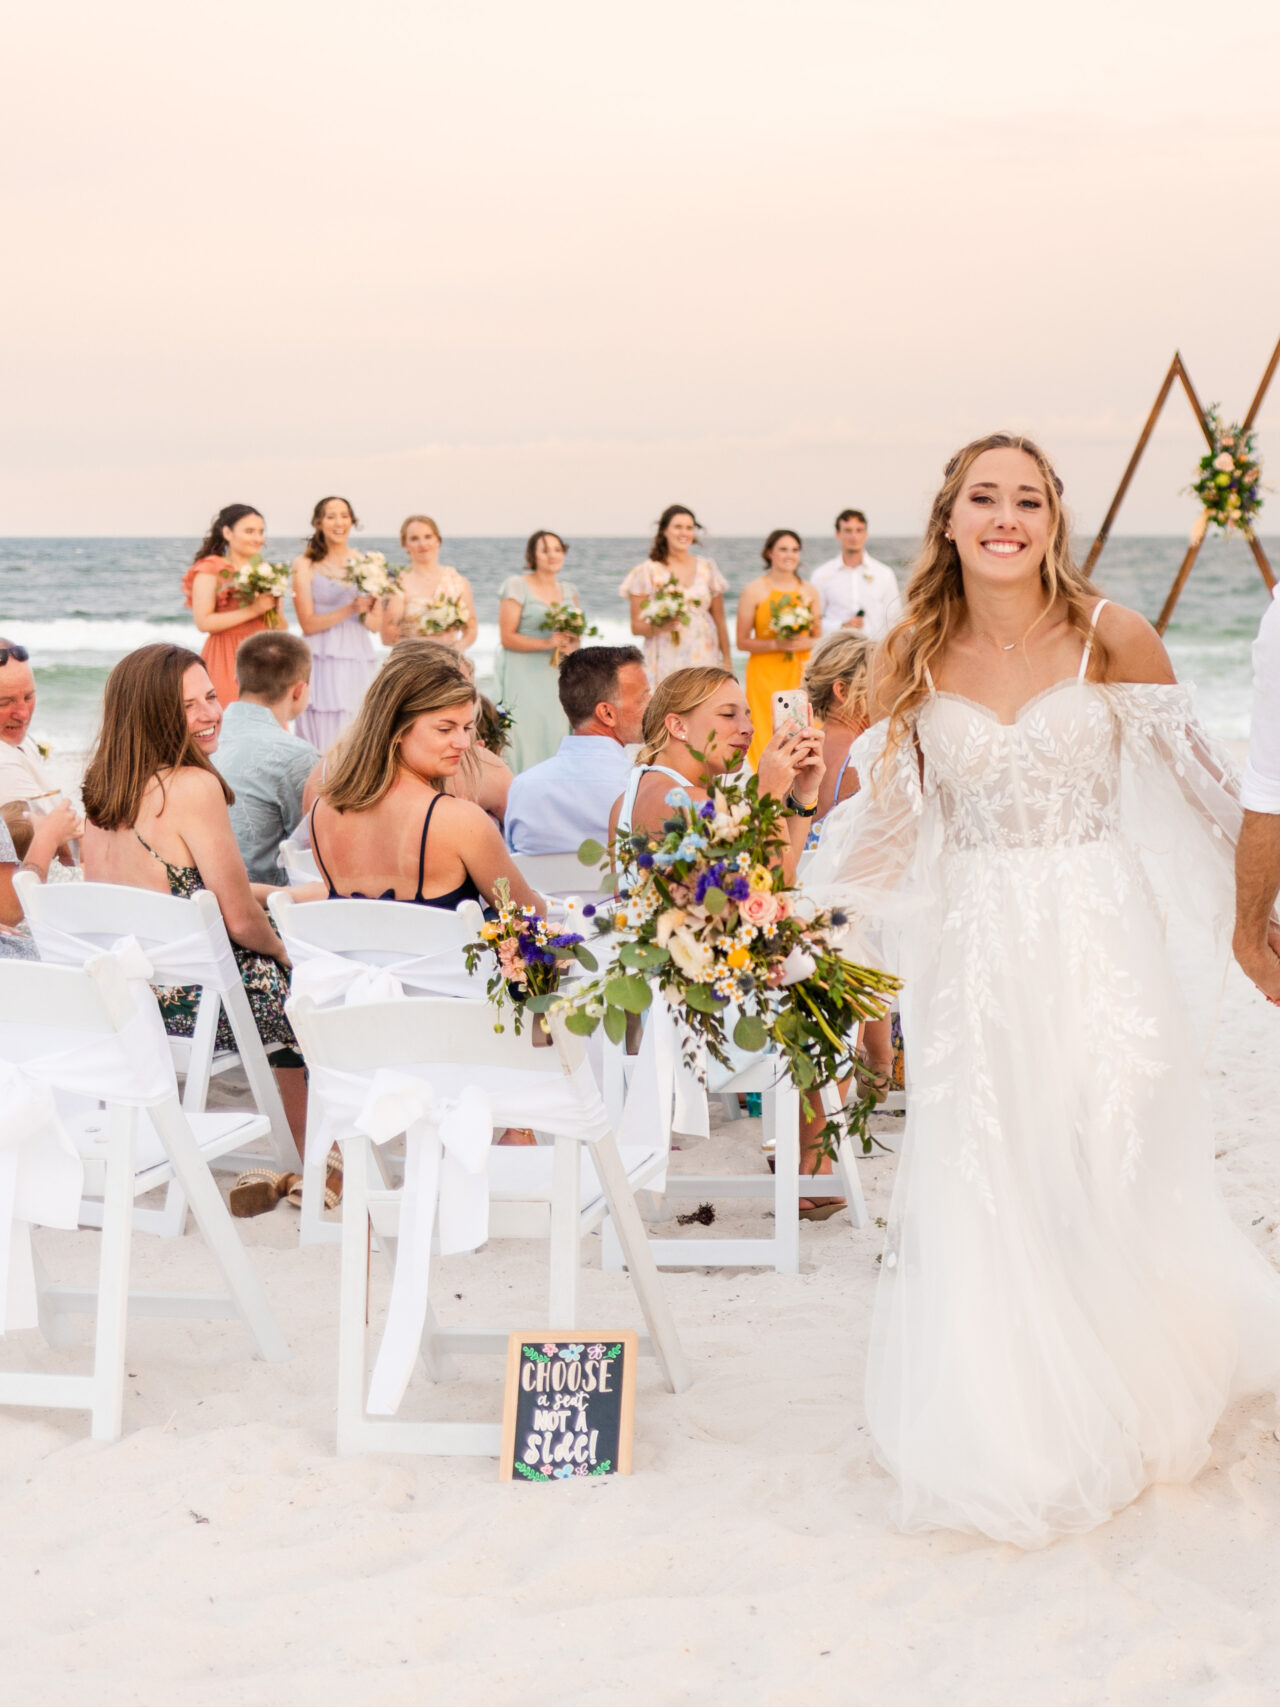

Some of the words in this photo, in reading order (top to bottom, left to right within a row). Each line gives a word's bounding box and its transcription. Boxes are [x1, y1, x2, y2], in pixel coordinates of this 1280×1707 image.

[521, 1359, 614, 1393] CHOOSE
[537, 1393, 551, 1407] a
[552, 1390, 590, 1411] seat
[533, 1410, 572, 1433] NOT
[574, 1410, 588, 1433] A
